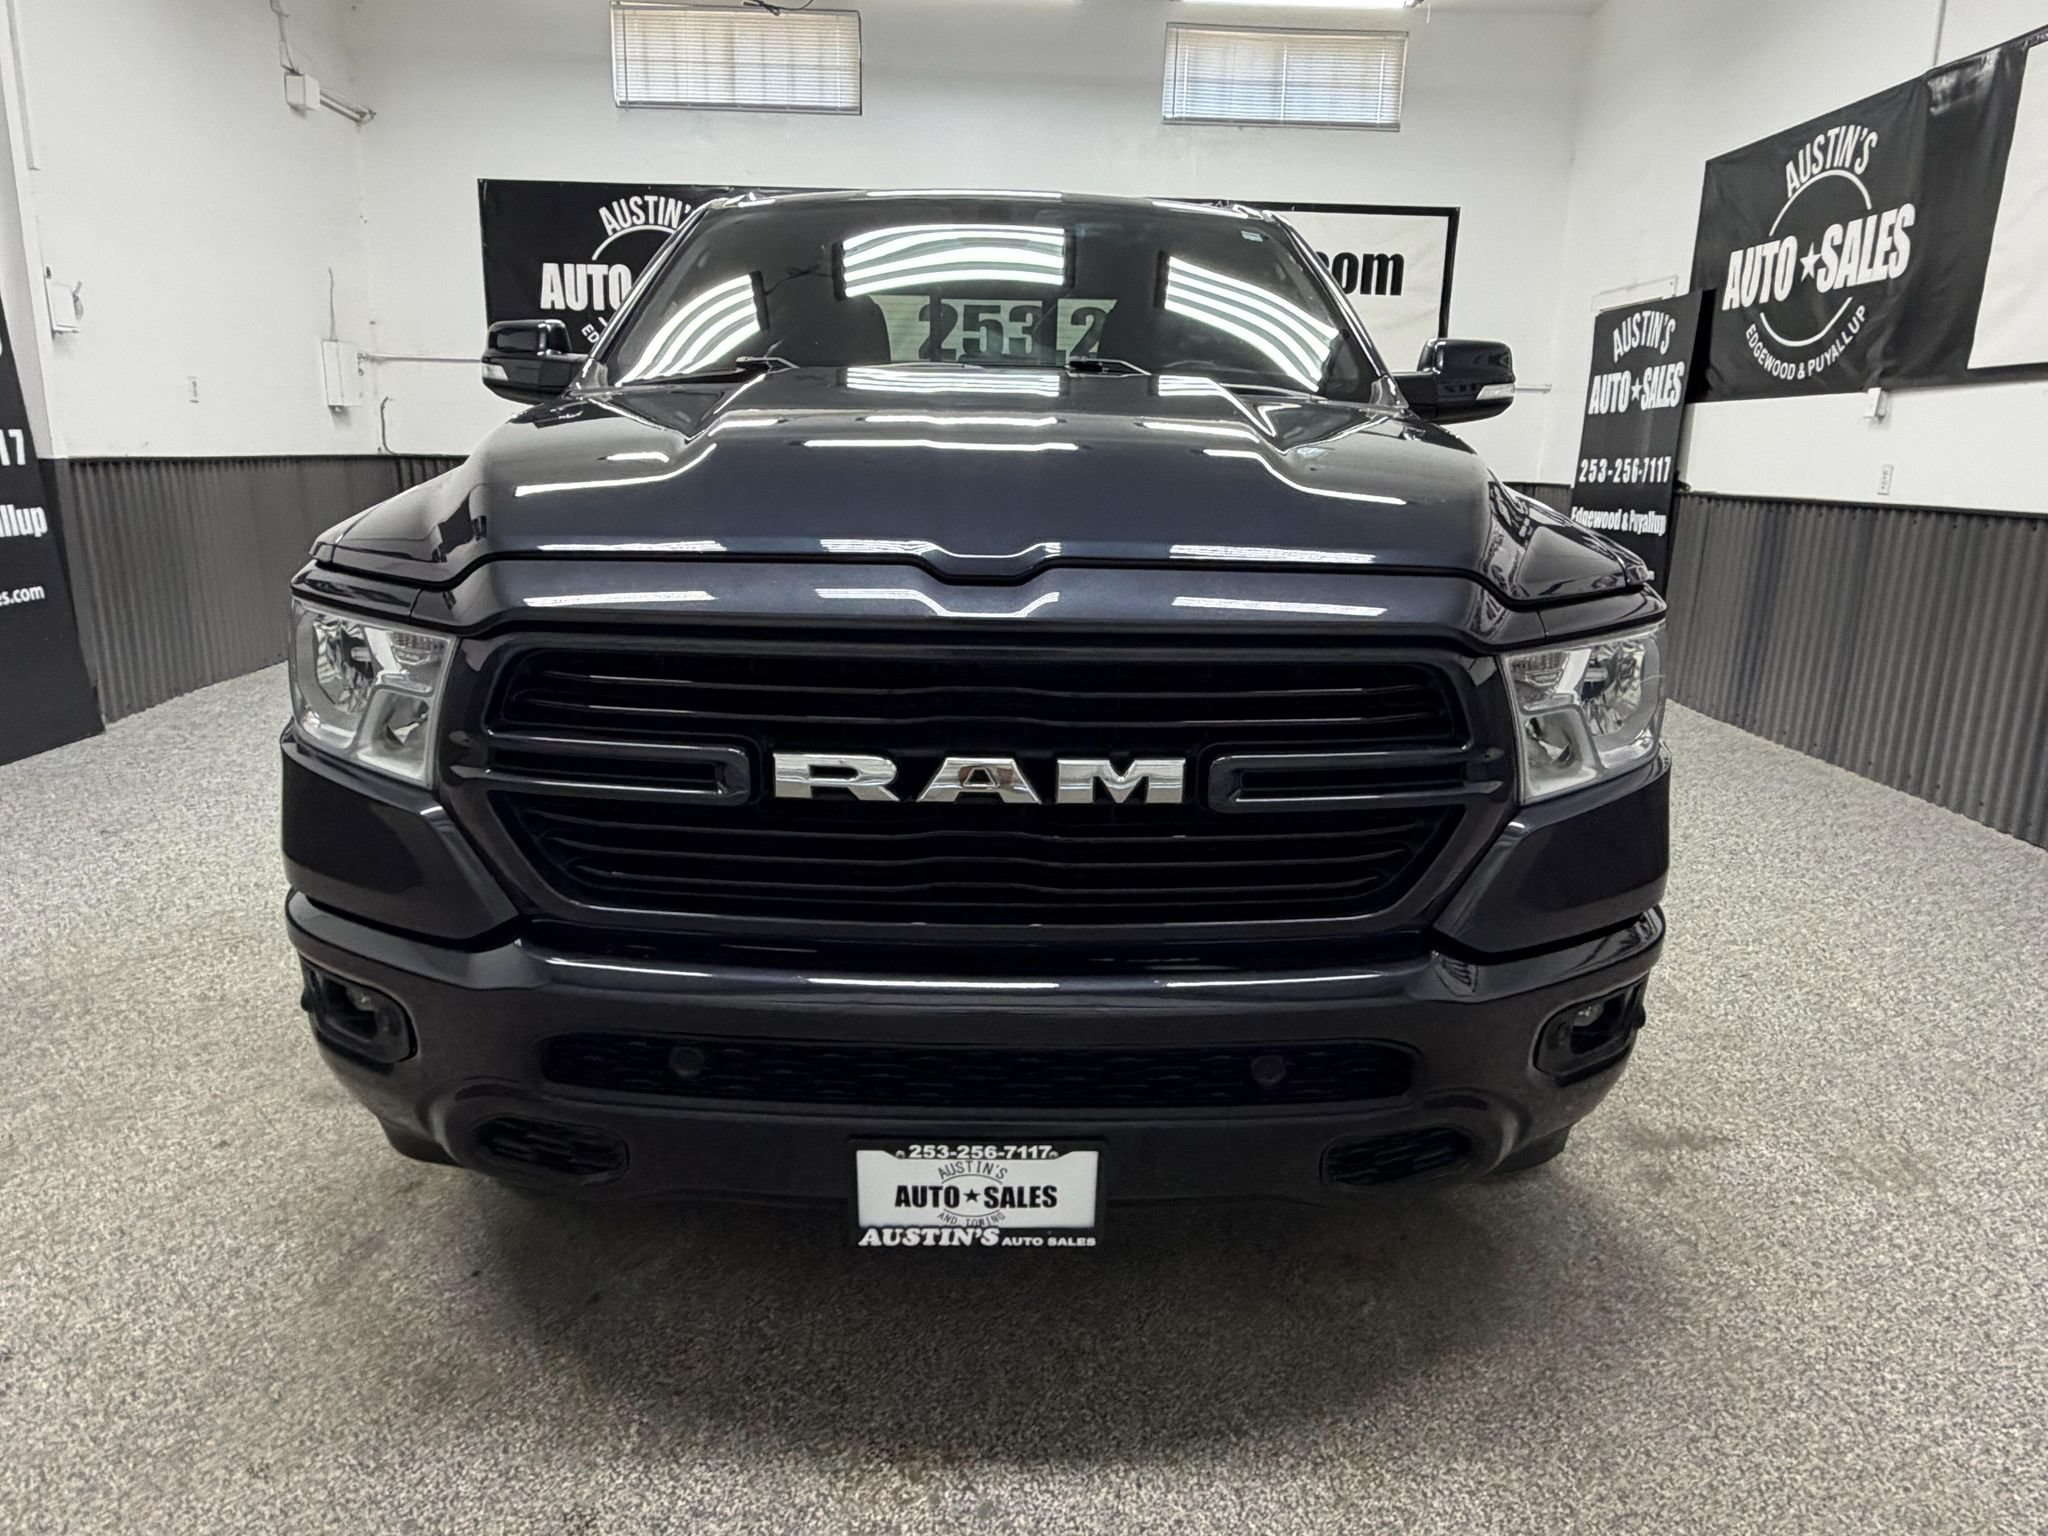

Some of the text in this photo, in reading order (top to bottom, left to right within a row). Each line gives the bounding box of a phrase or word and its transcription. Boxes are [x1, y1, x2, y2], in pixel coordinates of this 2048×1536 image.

[1786, 125, 1878, 197] AUSTIN'S
[598, 194, 692, 236] AUSTIN'
[1722, 203, 1916, 311] AUTO SALES
[540, 262, 633, 311] AUTO
[581, 323, 600, 343] ED
[1613, 310, 1676, 363] AUSTIN'S
[1746, 304, 1866, 380] EDGEWOOD & PUYALLUP
[1588, 361, 1685, 415] AUTO SALES
[1578, 456, 1672, 484] 253-256-7117
[0, 504, 48, 538] llup
[773, 752, 1186, 804] RAM
[909, 1144, 1052, 1159] 253-256-7117
[937, 1160, 1008, 1180] AUSTIN'S
[895, 1185, 1057, 1209] AUTO SALES
[858, 1227, 1096, 1247] AUSTIN'S AUTO SALES
